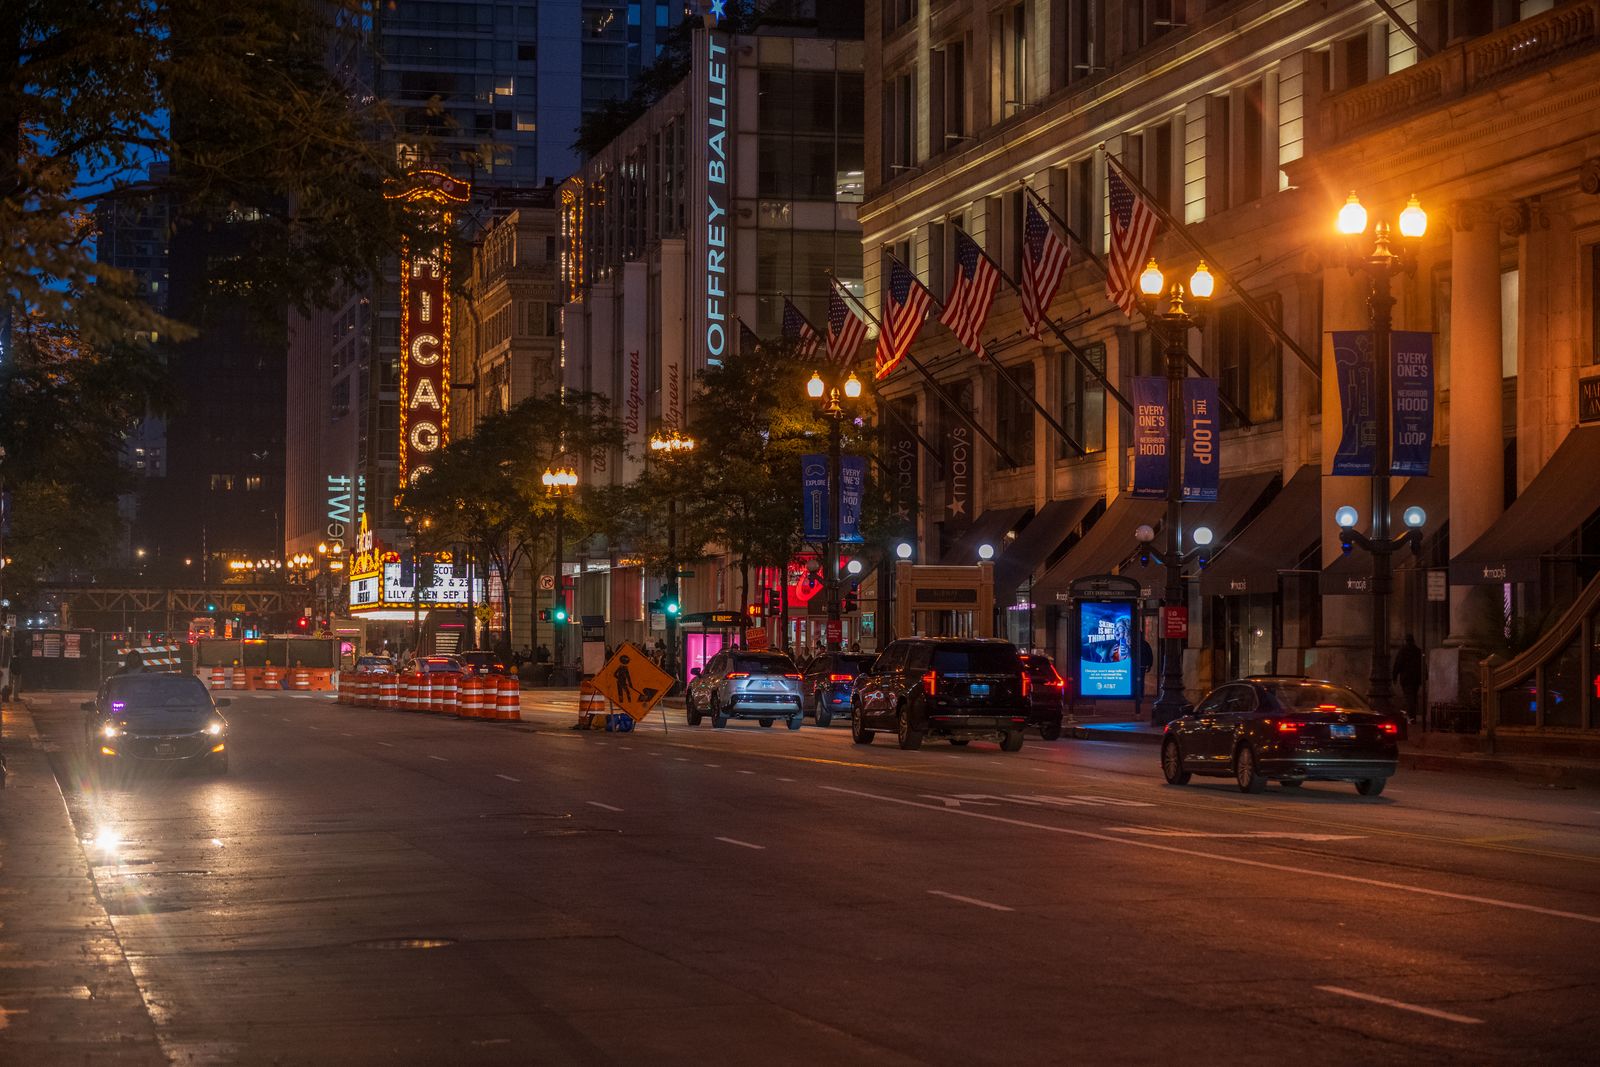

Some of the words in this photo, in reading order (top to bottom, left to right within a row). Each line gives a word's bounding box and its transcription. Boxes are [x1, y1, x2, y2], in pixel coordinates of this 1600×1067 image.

[709, 35, 727, 184] BALLET
[707, 195, 725, 369] JOFFREY
[1397, 352, 1427, 365] EVERY
[1397, 365, 1428, 378] ONE'S
[626, 350, 644, 435] Walgreens
[1397, 389, 1427, 398] NEIGHBOR
[1139, 405, 1164, 416] EVERY
[1197, 400, 1207, 416] THE
[1397, 398, 1428, 412] HOOD
[1139, 416, 1166, 427] ONE'S
[1407, 423, 1418, 431] THE
[1193, 419, 1213, 465] LOOP
[1399, 432, 1427, 446] LOOP
[1139, 444, 1166, 456] HOOD
[842, 468, 860, 477] EVERY
[448, 579, 455, 587] &
[388, 590, 407, 599] LILY
[443, 590, 460, 599] SEP
